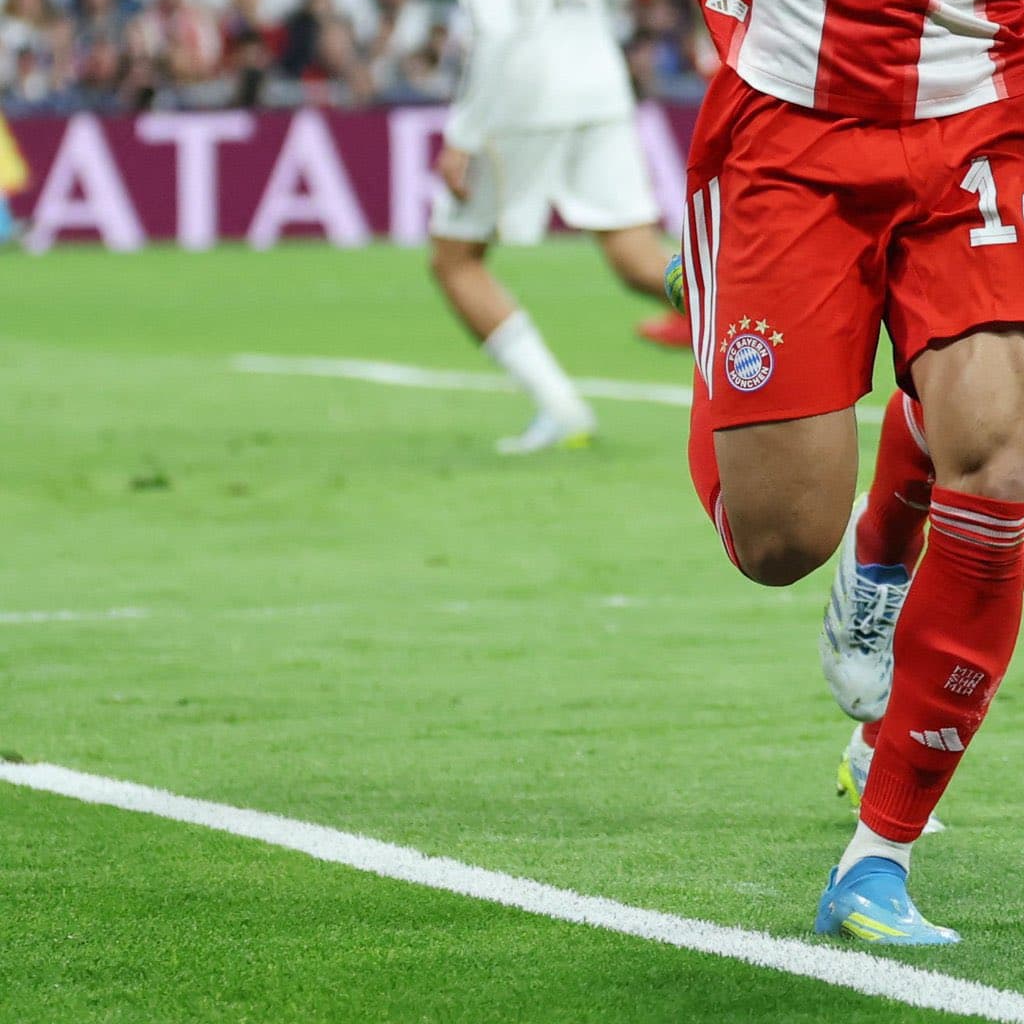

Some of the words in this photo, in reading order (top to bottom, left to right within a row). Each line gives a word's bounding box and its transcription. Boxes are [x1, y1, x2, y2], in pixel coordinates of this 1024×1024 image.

[736, 337, 768, 358] BAYERN
[952, 665, 985, 683] MIA
[943, 680, 974, 696] MIA
